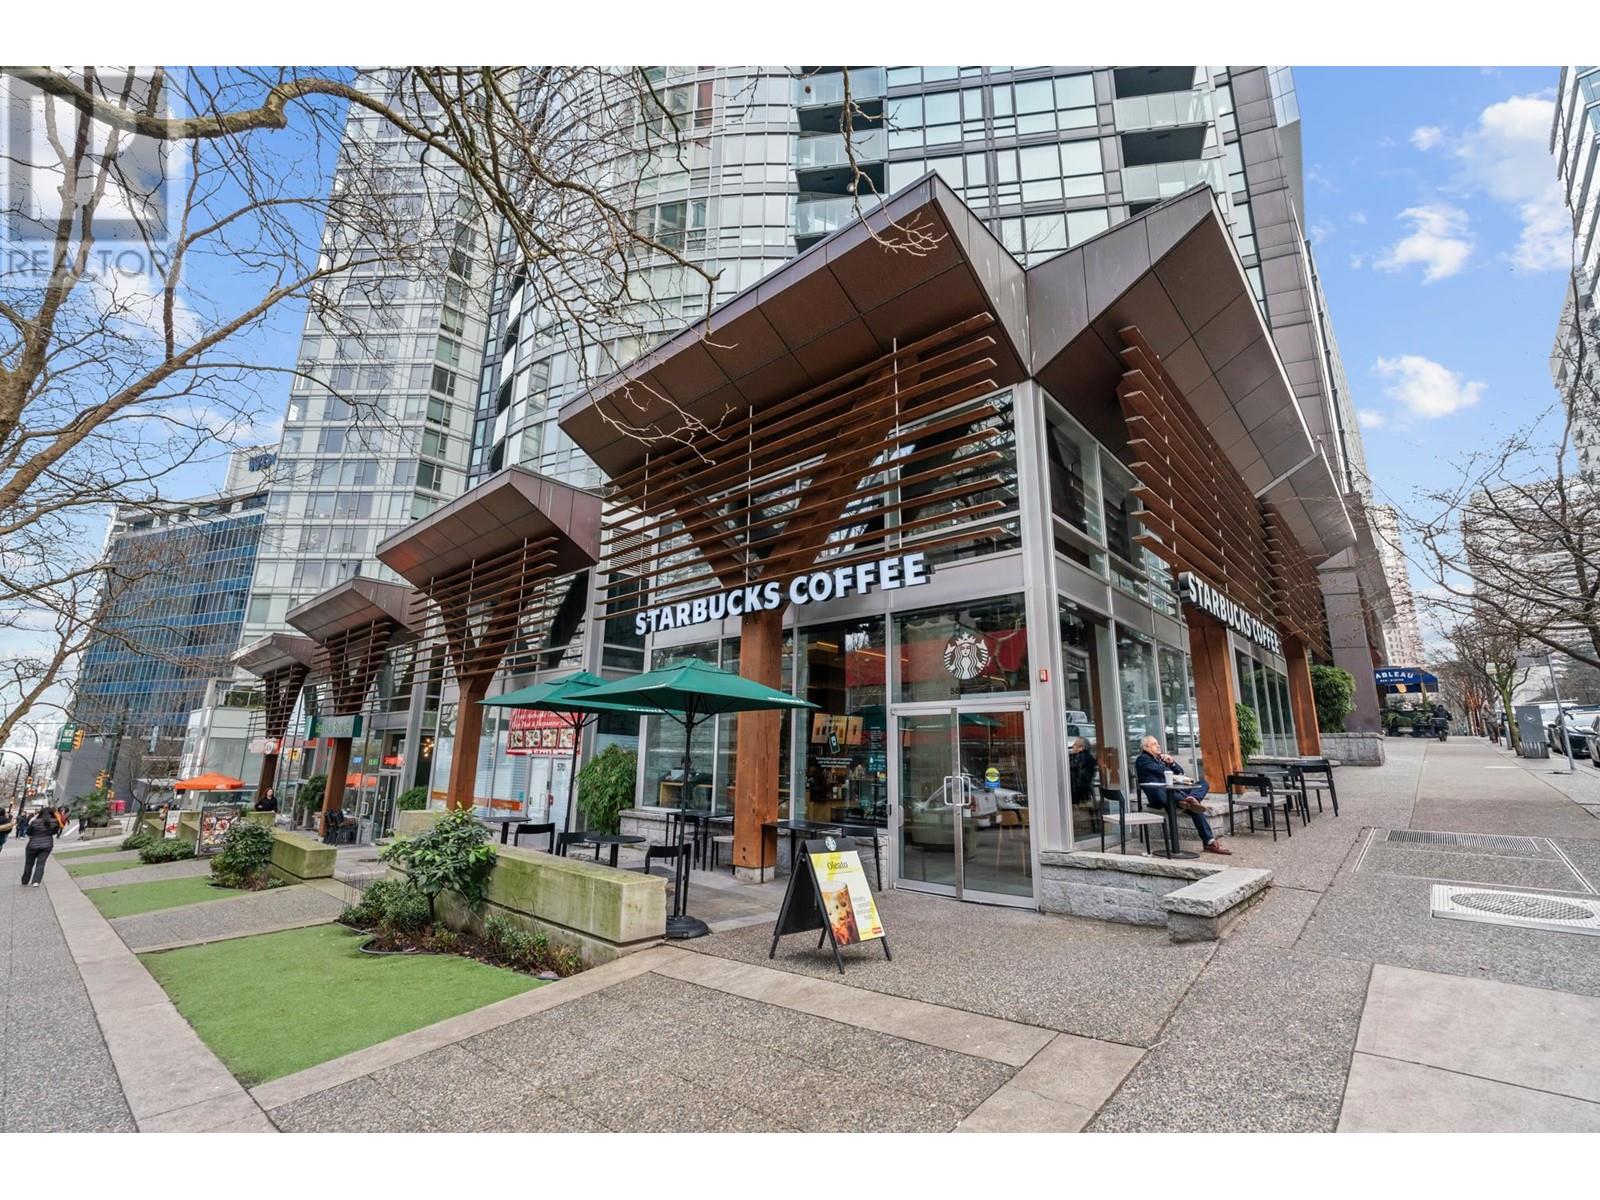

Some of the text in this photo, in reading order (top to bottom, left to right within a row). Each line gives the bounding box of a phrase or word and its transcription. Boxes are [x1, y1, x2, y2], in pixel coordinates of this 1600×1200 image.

[635, 552, 928, 636] STARBUCKS COFFEE
[1187, 573, 1281, 654] STARBUCKS COFFEE
[1376, 671, 1414, 680] ABLEAU
